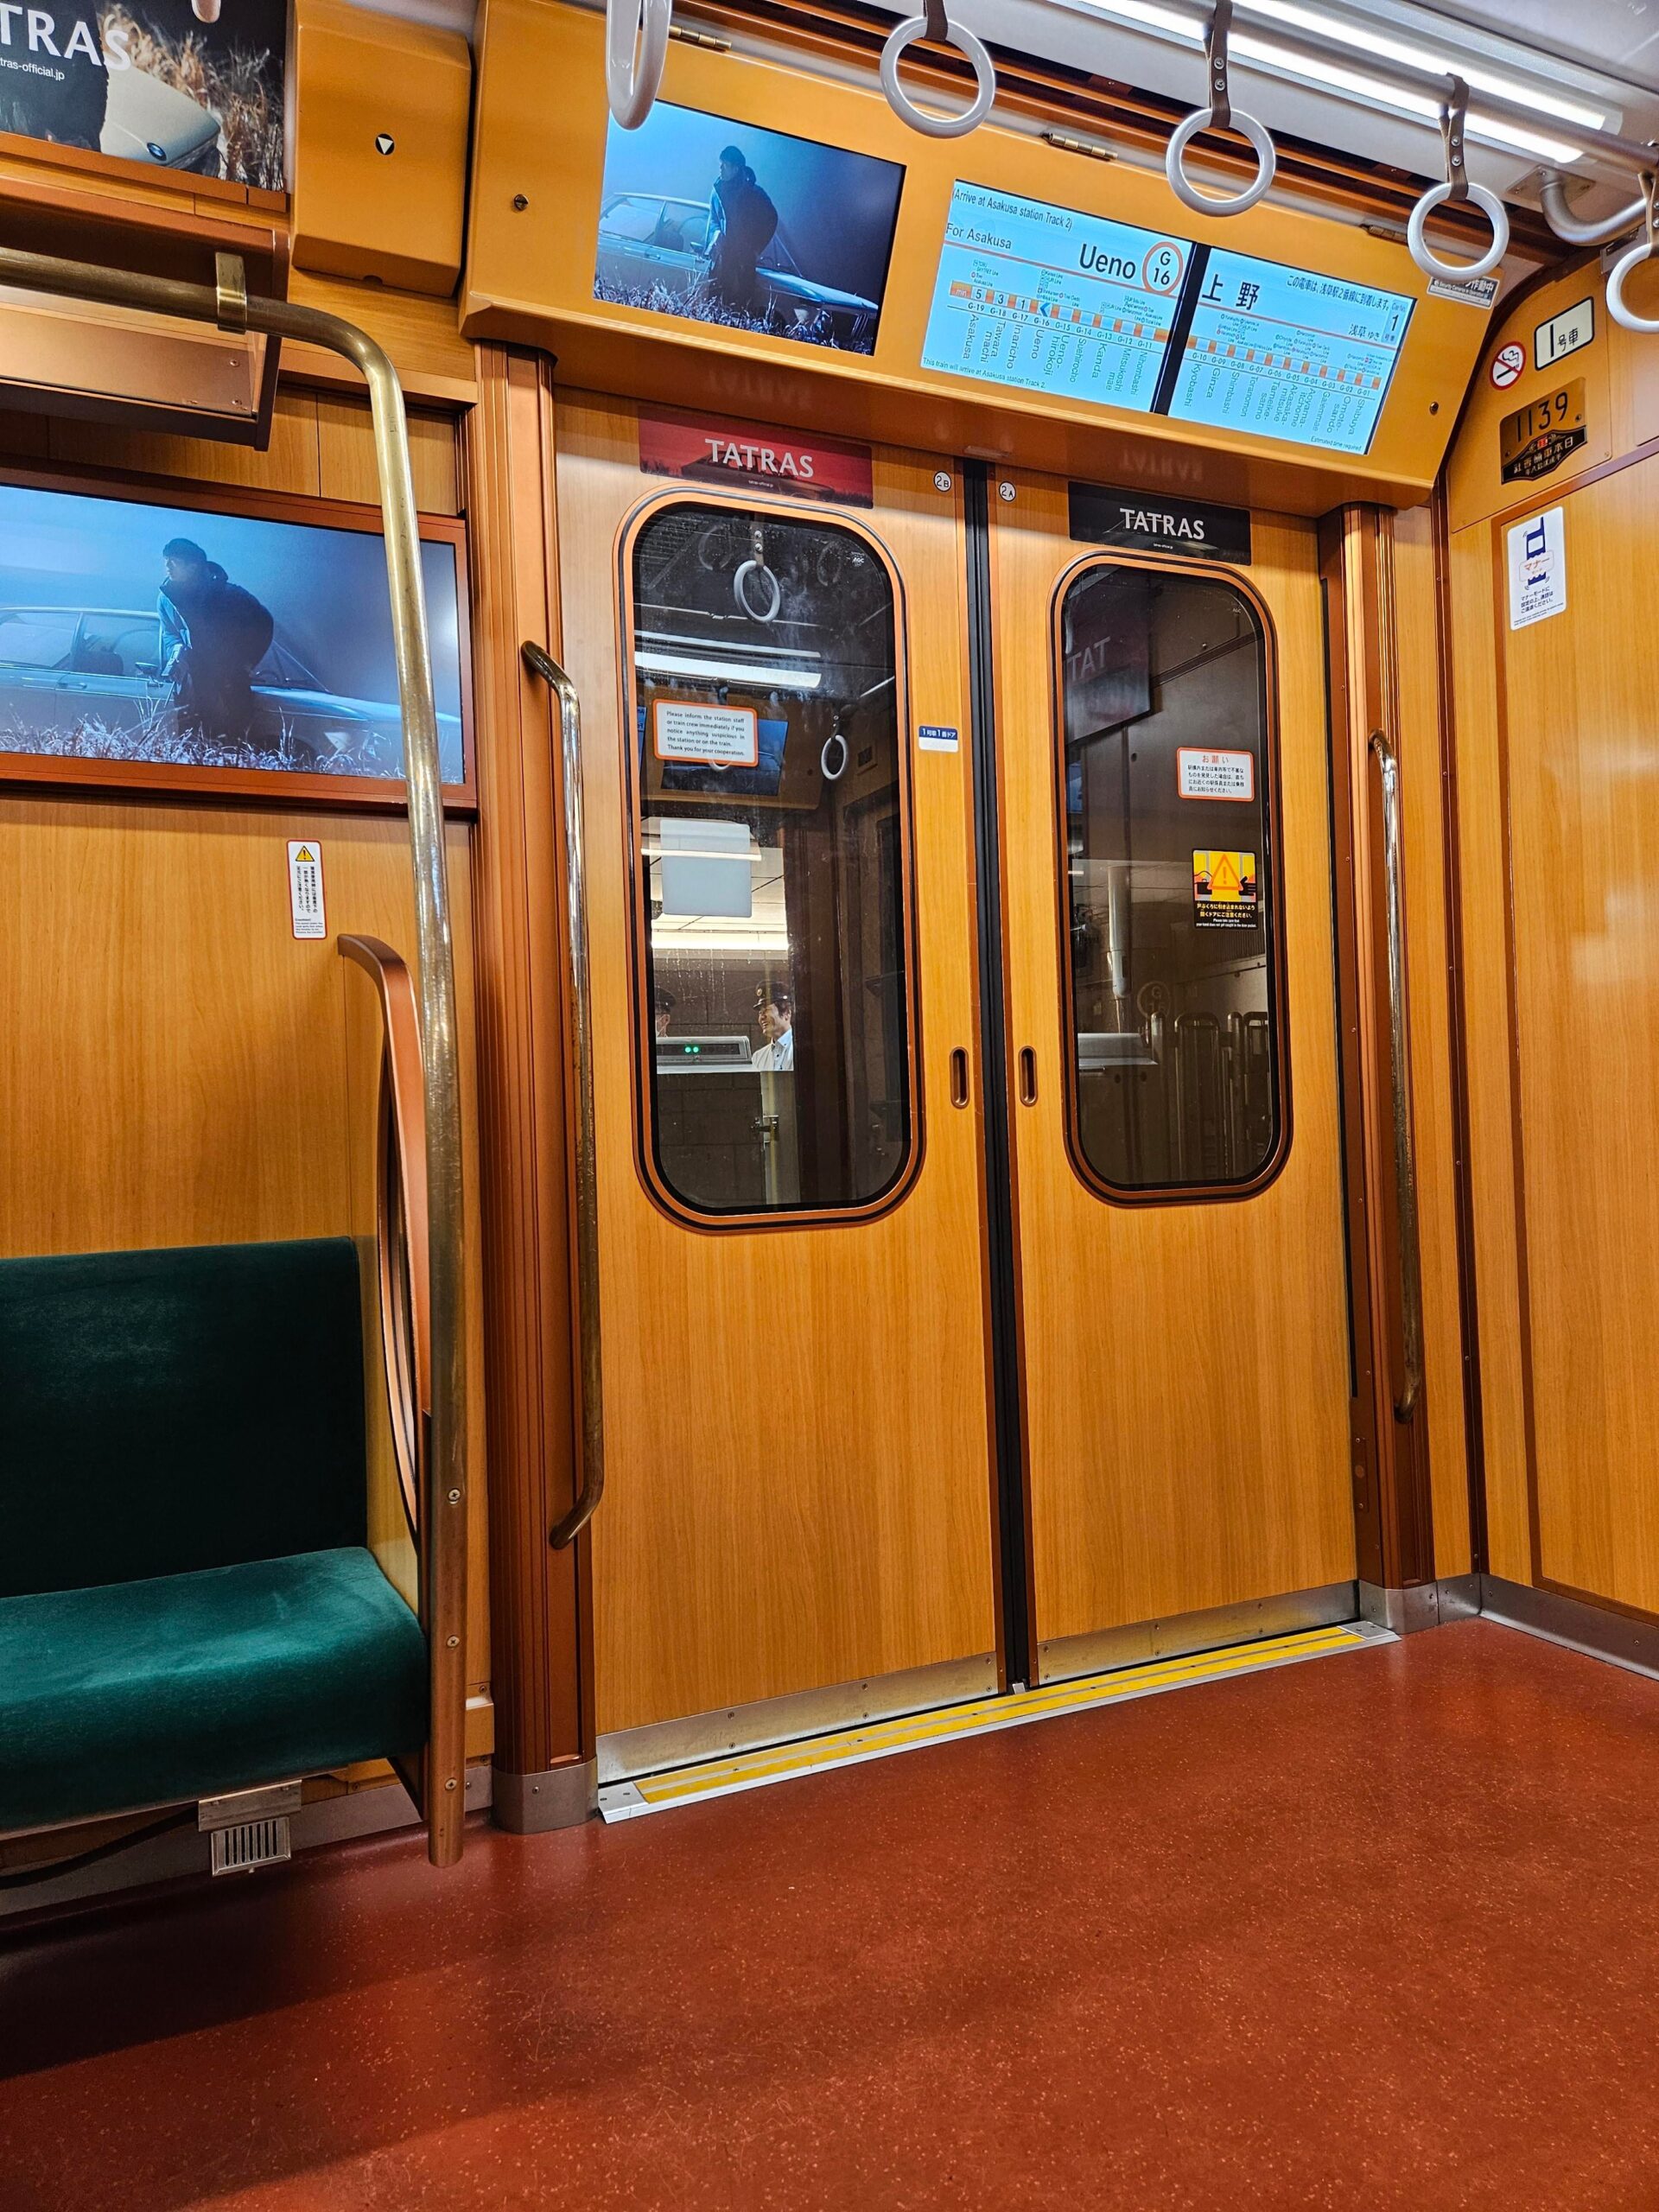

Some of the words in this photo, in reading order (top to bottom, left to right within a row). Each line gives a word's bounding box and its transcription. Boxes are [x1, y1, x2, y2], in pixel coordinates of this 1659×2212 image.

[978, 196, 986, 207] at
[987, 197, 1018, 215] Asakusa
[1020, 207, 1044, 221] station
[1046, 212, 1064, 227] Track
[1065, 217, 1073, 232] 2)
[945, 222, 964, 238] For
[967, 228, 1012, 250] Asakusa
[1079, 243, 1136, 279] Ueno
[1160, 251, 1172, 266] G
[1154, 267, 1170, 285] 16
[1202, 274, 1260, 310] 上野
[976, 289, 982, 299] 5
[997, 294, 1004, 304] 3
[1020, 299, 1026, 309] 1
[963, 314, 979, 359] Asakusa
[968, 302, 985, 312] G-19
[990, 308, 1007, 317] G-18
[1012, 312, 1028, 321] G-17
[1033, 317, 1050, 327] G-16
[1055, 321, 1071, 331] G-15
[1076, 326, 1091, 336] G-14
[1096, 331, 1112, 340] G-13
[1117, 335, 1133, 345] G-12
[1138, 340, 1152, 349] G-11
[990, 321, 1006, 357] Tawara
[1392, 315, 1399, 332] 1
[981, 331, 992, 363] machi
[1007, 324, 1023, 370] Inaricho
[1031, 329, 1045, 359] Ueno
[1044, 335, 1061, 376] hirokoji
[1057, 334, 1070, 369] Ueno-
[1070, 338, 1087, 383] Suehirocho
[1092, 342, 1107, 378] Kanda
[1115, 347, 1132, 392] Mitsukoshi
[1192, 352, 1207, 361] G-10
[1211, 356, 1226, 365] G-09
[1249, 365, 1263, 374] G-07
[1107, 372, 1116, 391] mae
[1185, 363, 1202, 407] Kyobashi
[1206, 367, 1221, 398] Ginza
[1222, 371, 1240, 415] Shimbashi
[1255, 392, 1267, 420] sanno
[1274, 388, 1287, 422] mitsuke
[1326, 404, 1340, 433] sando
[1348, 398, 1365, 435] Shibuya
[1517, 391, 1568, 442] 1139
[705, 438, 814, 478] TATRAS
[936, 475, 950, 488] 2B
[1001, 486, 1014, 498] 2A
[1120, 507, 1205, 540] TATRAS
[1524, 557, 1550, 570] マナー
[700, 722, 730, 731] immediately
